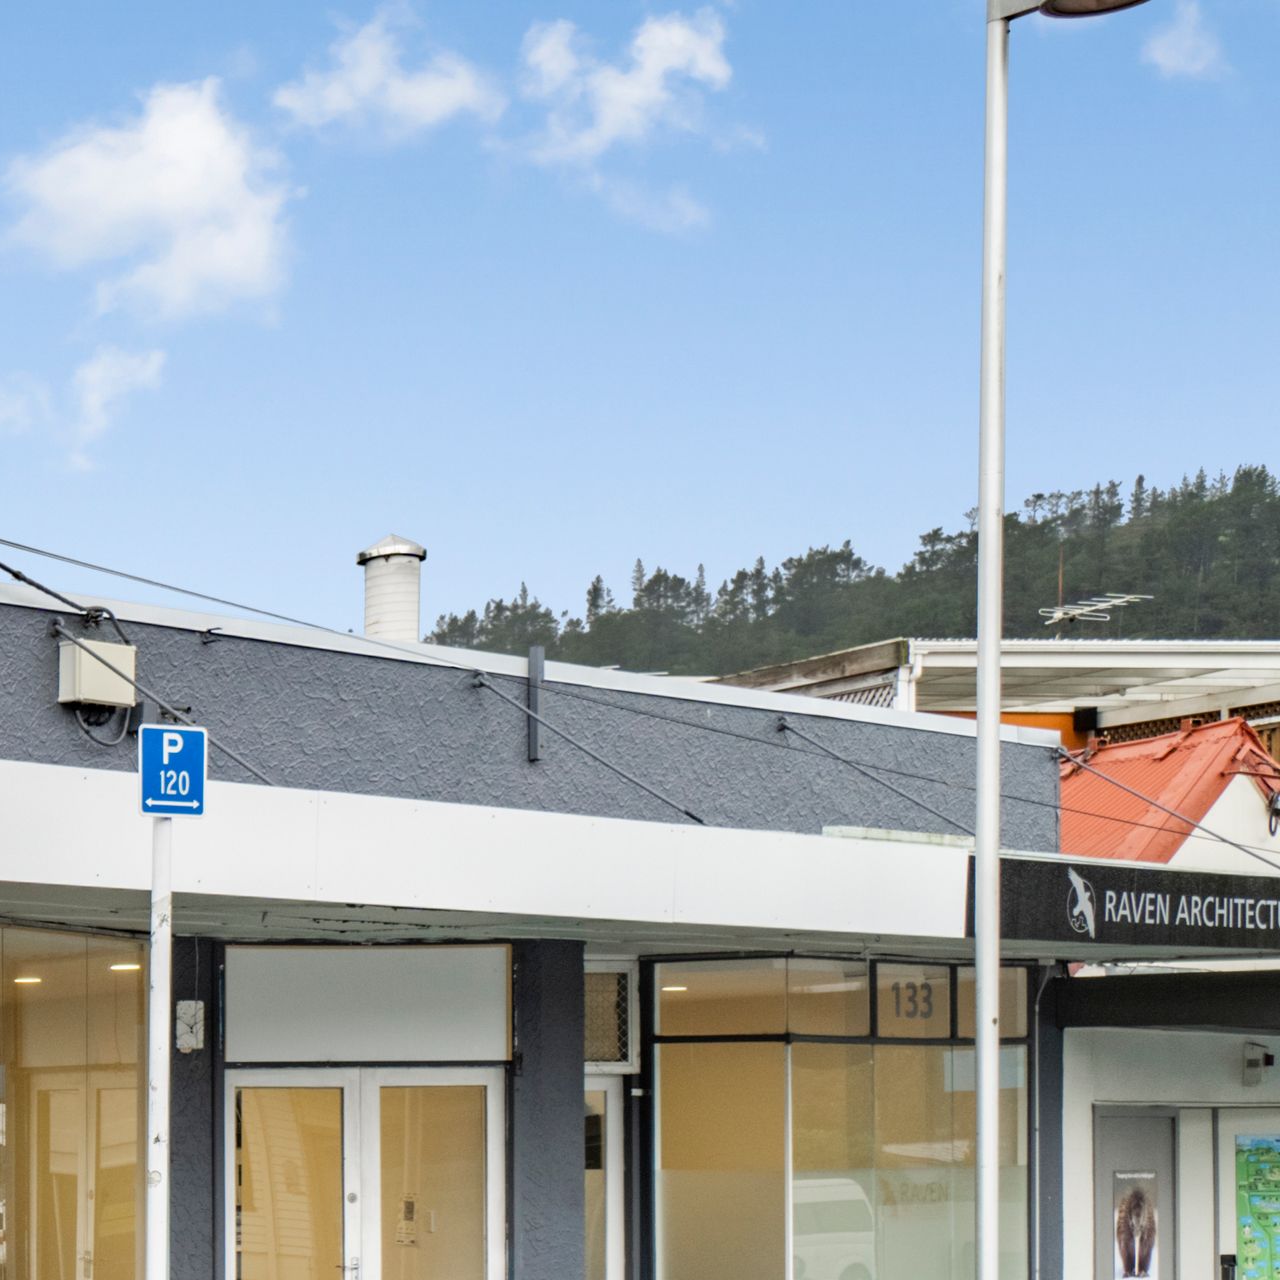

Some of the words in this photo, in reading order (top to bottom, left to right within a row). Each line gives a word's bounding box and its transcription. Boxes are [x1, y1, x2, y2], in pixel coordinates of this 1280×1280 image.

[162, 731, 184, 765] P
[159, 769, 190, 796] 120
[1104, 890, 1171, 925] RAVEN
[1175, 895, 1280, 930] ARCHITECT
[891, 981, 933, 1019] 133
[900, 1182, 949, 1202] RAVEN
